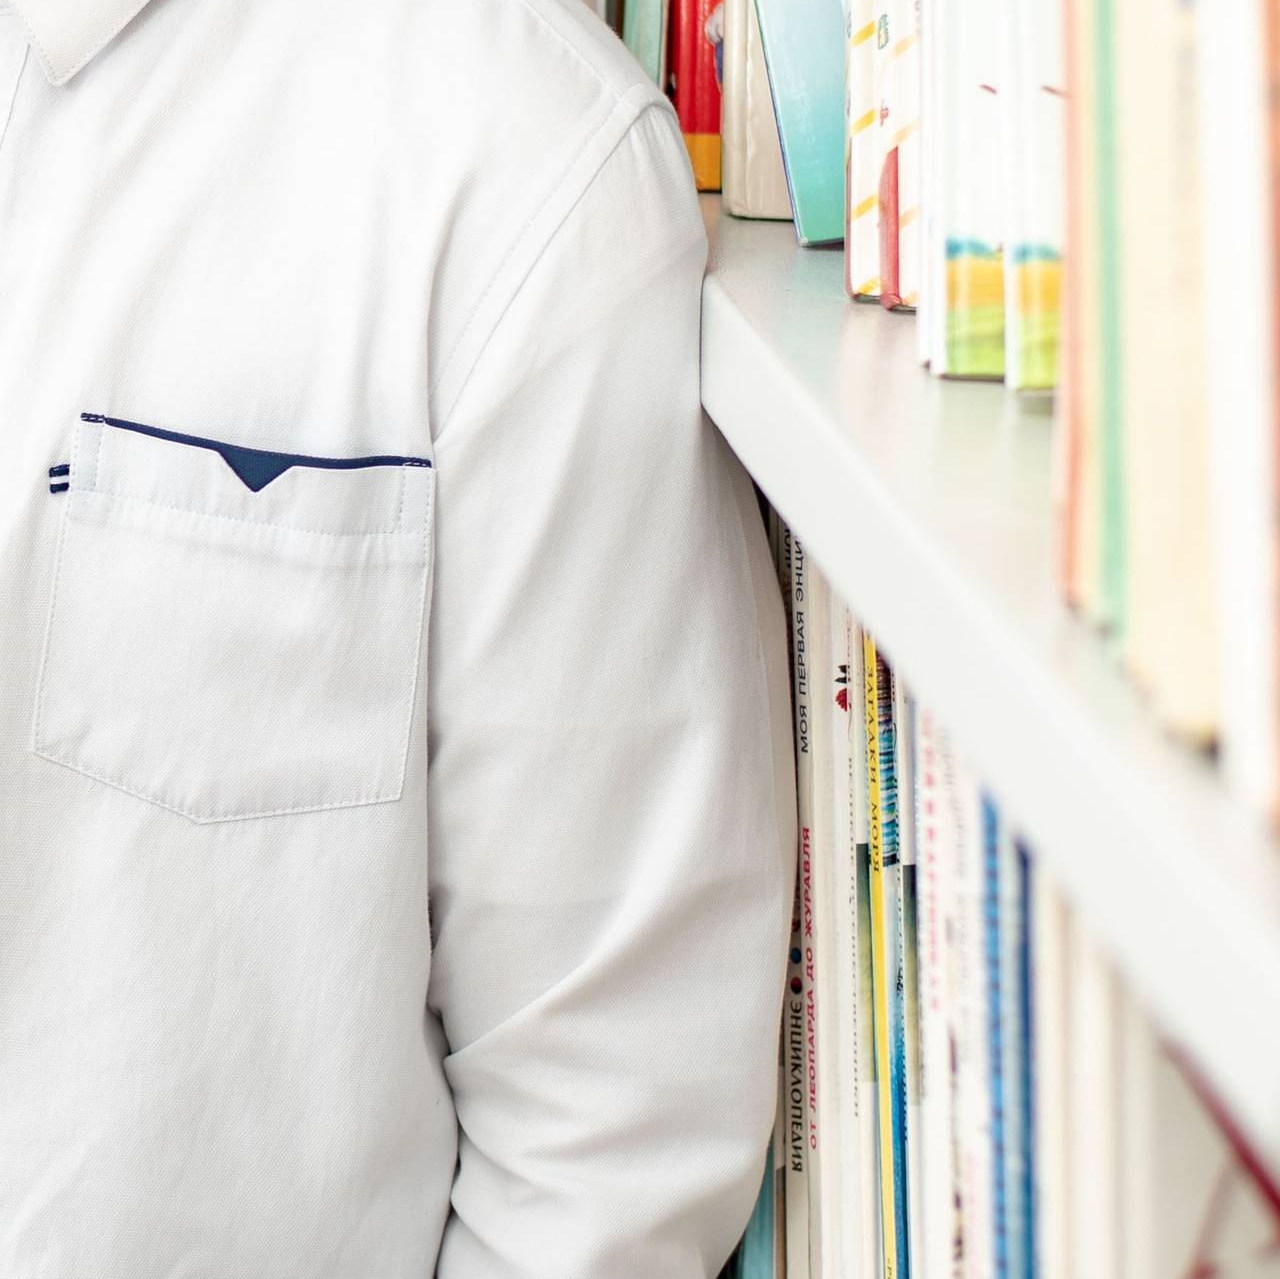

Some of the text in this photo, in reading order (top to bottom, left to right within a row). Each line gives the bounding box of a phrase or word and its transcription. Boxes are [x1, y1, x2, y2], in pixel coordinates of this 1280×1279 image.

[797, 611, 808, 696] ПЕРВАЯ
[800, 705, 810, 753] МОЯ
[866, 665, 880, 873] ЗАГАДКИ МОРЯ
[802, 827, 818, 1150] ОТ ЛЕОПАРДА ДО ЖУРАВЛЯ
[789, 1000, 804, 1173] ЭНЦИКЛОПЕДИЯ
